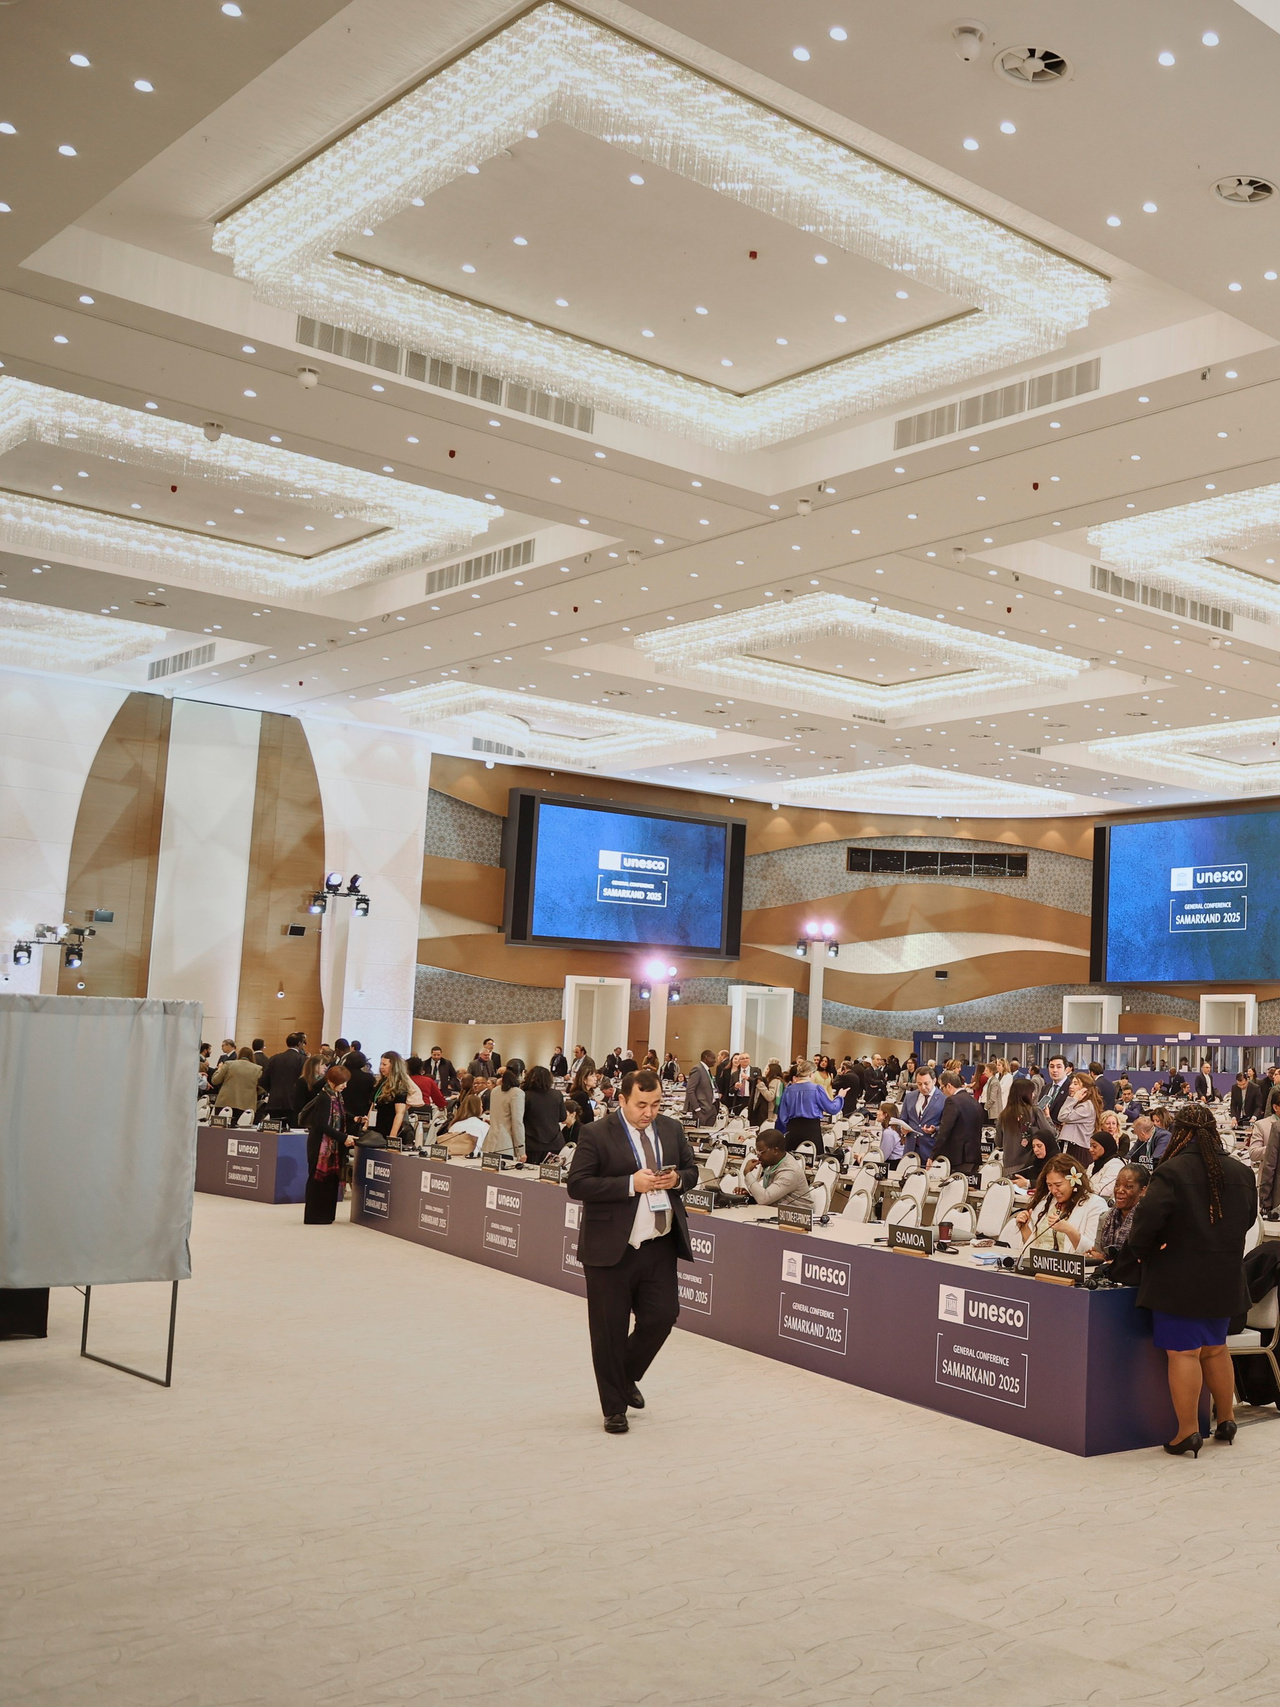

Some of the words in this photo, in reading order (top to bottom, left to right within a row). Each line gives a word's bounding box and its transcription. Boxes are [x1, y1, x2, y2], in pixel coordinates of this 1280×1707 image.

[623, 857, 666, 871] unesco
[1196, 870, 1243, 884] unesco
[603, 887, 645, 900] SAMARKAND
[646, 891, 662, 901] 2025
[1204, 901, 1231, 909] CONFERENCE
[1175, 913, 1221, 925] SAMARKAND
[1223, 912, 1241, 923] 2025
[238, 1144, 259, 1155] unesco
[374, 1166, 390, 1178] unesco
[431, 1179, 450, 1192] unesco
[498, 1193, 520, 1209] unesco
[485, 1231, 507, 1247] SAMARKAND
[690, 1238, 712, 1255] esco
[895, 1231, 925, 1248] SAMOA
[1032, 1255, 1082, 1276] SAINTE-LUCIE
[683, 1273, 703, 1284] CONFERENCE
[805, 1263, 847, 1286] unesco
[694, 1289, 708, 1304] 2025
[792, 1302, 810, 1313] GENERAL
[809, 1307, 835, 1320] CONFERENCE
[968, 1299, 1025, 1328] unesco
[783, 1315, 824, 1338] SAMARKAND
[825, 1326, 842, 1343] 2025
[953, 1344, 976, 1358] GENERAL
[976, 1350, 1010, 1367] CONFERENCE
[942, 1358, 996, 1387] SAMARKAND
[998, 1373, 1020, 1394] 2025
